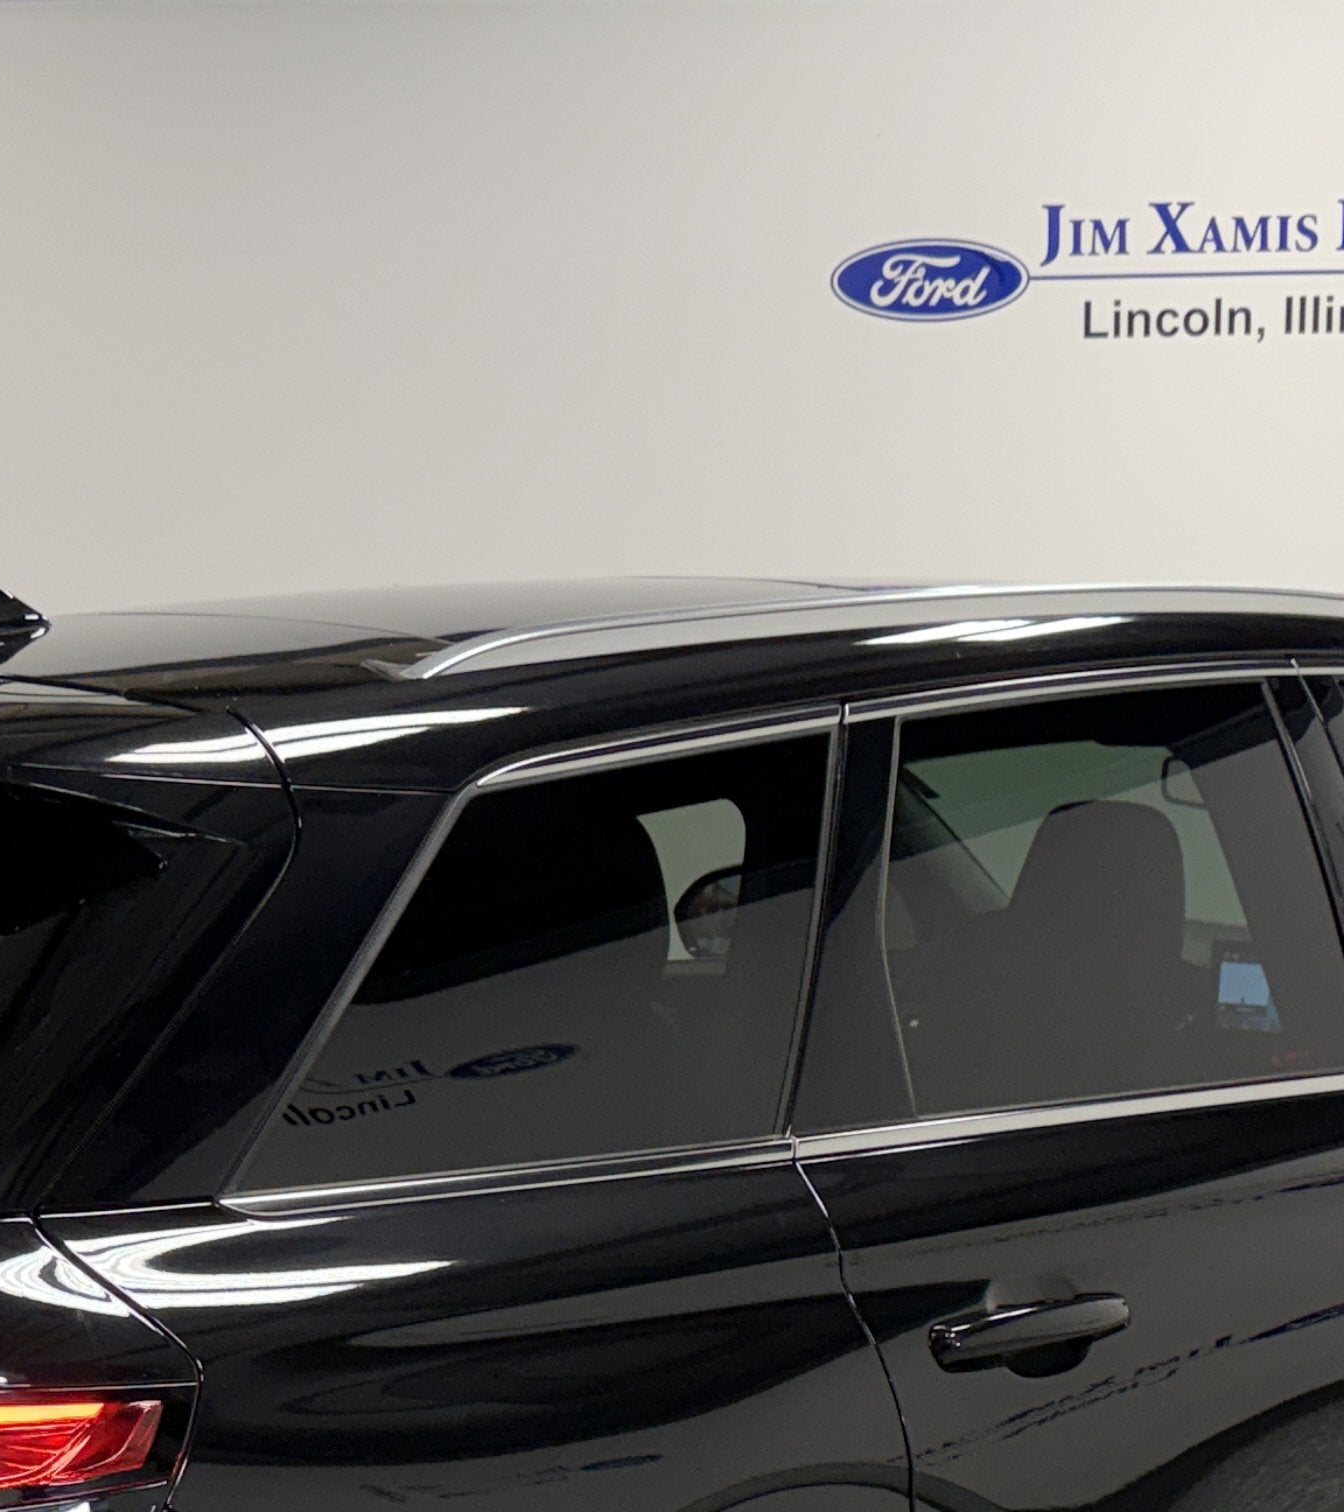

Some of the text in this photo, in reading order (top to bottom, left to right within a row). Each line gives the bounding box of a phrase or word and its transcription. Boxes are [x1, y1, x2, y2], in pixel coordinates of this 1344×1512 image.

[1039, 203, 1130, 268] JIM
[1146, 201, 1320, 255] XAMIS
[869, 253, 991, 307] Ford
[1083, 297, 1265, 344] Lincoln,
